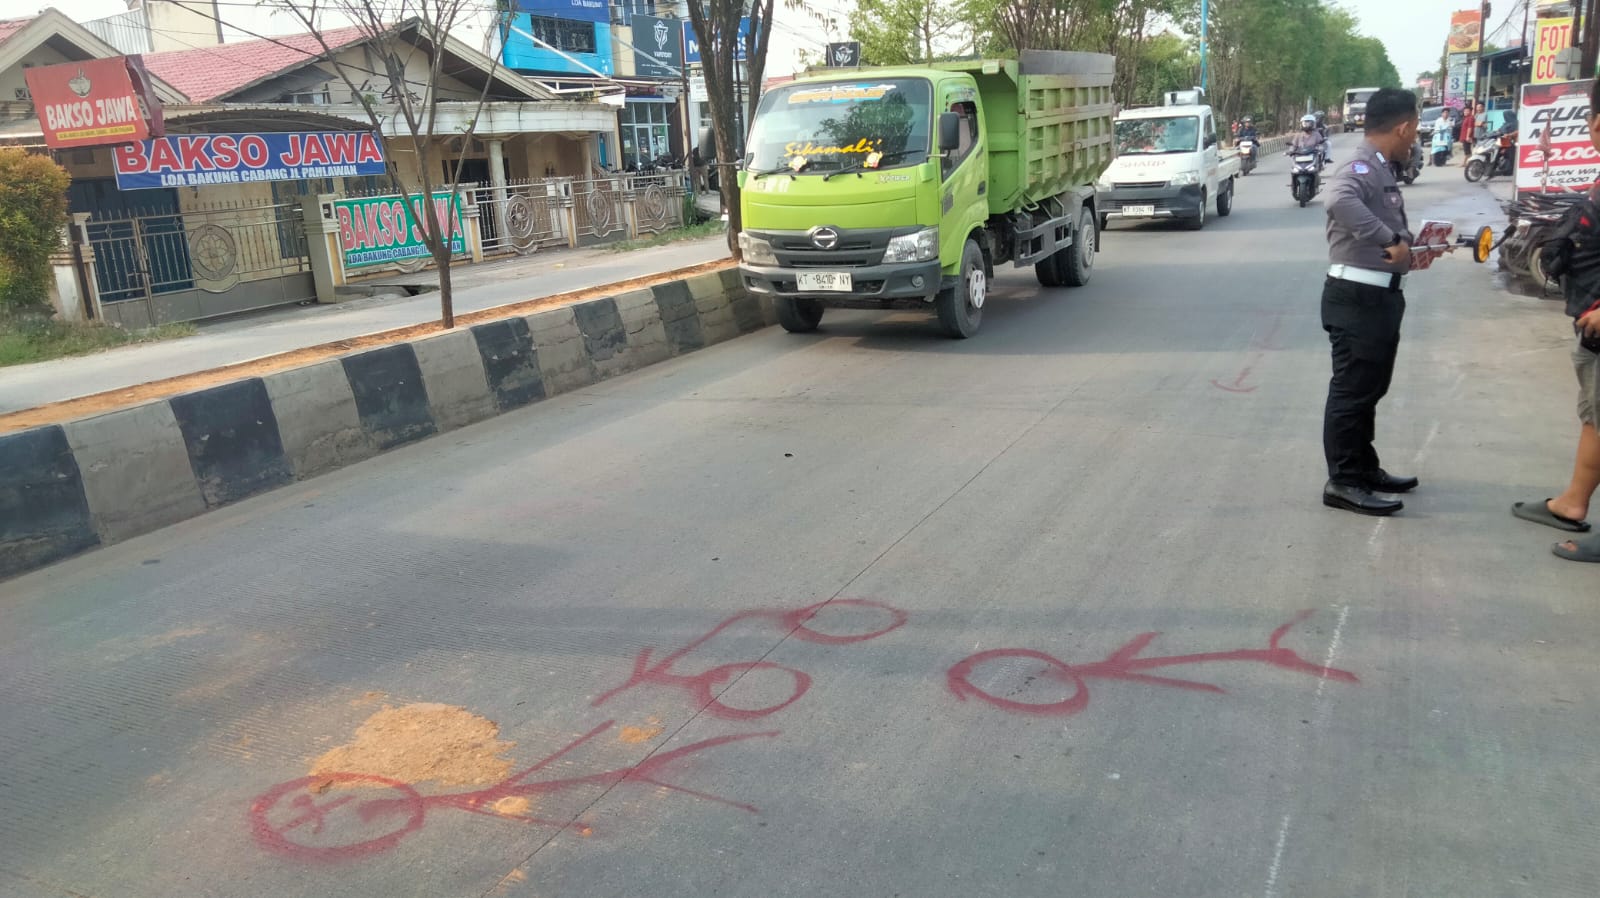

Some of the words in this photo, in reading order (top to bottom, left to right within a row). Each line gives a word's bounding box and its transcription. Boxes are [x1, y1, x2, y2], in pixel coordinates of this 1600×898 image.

[1540, 25, 1573, 51] FOT
[45, 101, 94, 130] BAKSO
[96, 95, 137, 125] JAWA
[1528, 125, 1591, 139] MOTO
[115, 135, 269, 174] BAKSO
[280, 132, 384, 167] JAWA
[161, 174, 185, 187] LOA
[187, 171, 239, 185] BAKUNG
[241, 168, 288, 181] CABANG
[302, 165, 358, 178] PAHLAWAN
[1532, 170, 1575, 178] SLON
[336, 201, 408, 251] BAKSO
[412, 196, 463, 243] JWA
[363, 248, 392, 261] BAKUNG
[798, 274, 808, 285] KT
[839, 275, 850, 286] NY
